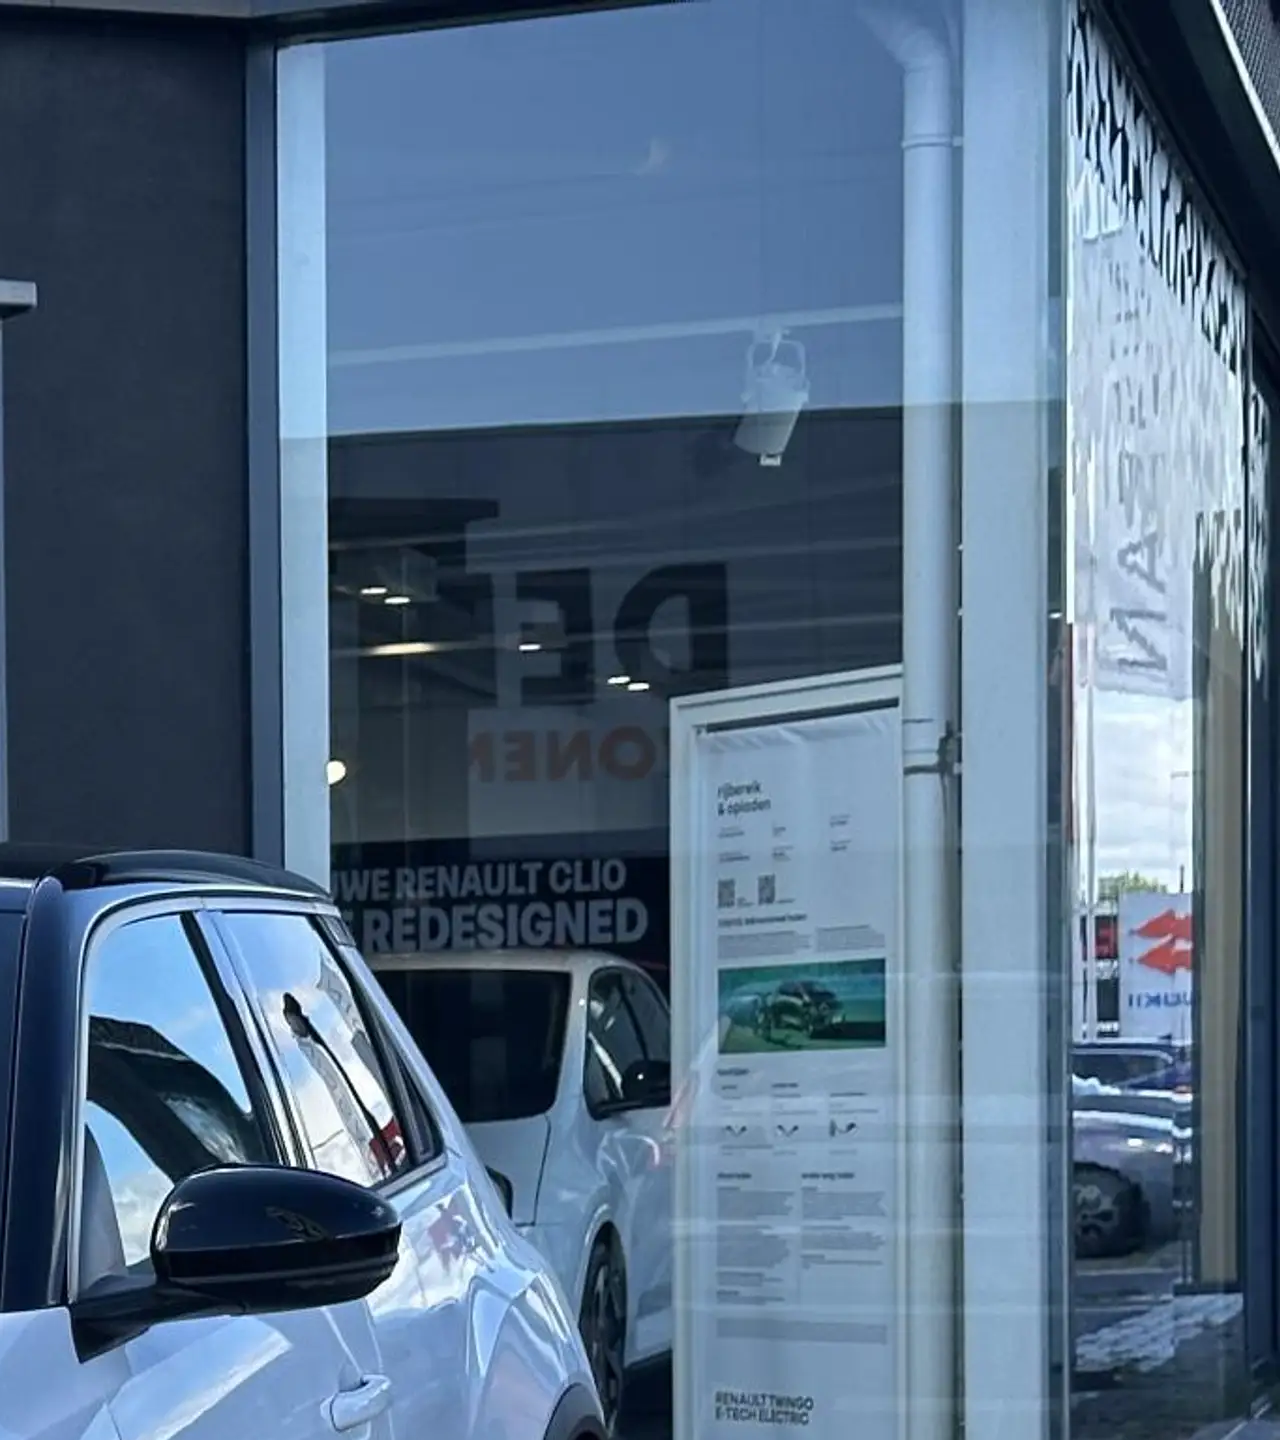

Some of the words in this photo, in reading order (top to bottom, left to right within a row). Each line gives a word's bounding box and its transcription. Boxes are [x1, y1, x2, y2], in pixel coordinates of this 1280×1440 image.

[396, 862, 543, 900] RENAULT
[548, 858, 628, 894] CLIO
[362, 897, 650, 957] REDESIGNED
[715, 1390, 768, 1408] RENAULT
[768, 1394, 814, 1411] TWINGO
[758, 1408, 809, 1426] ELECTRIC
